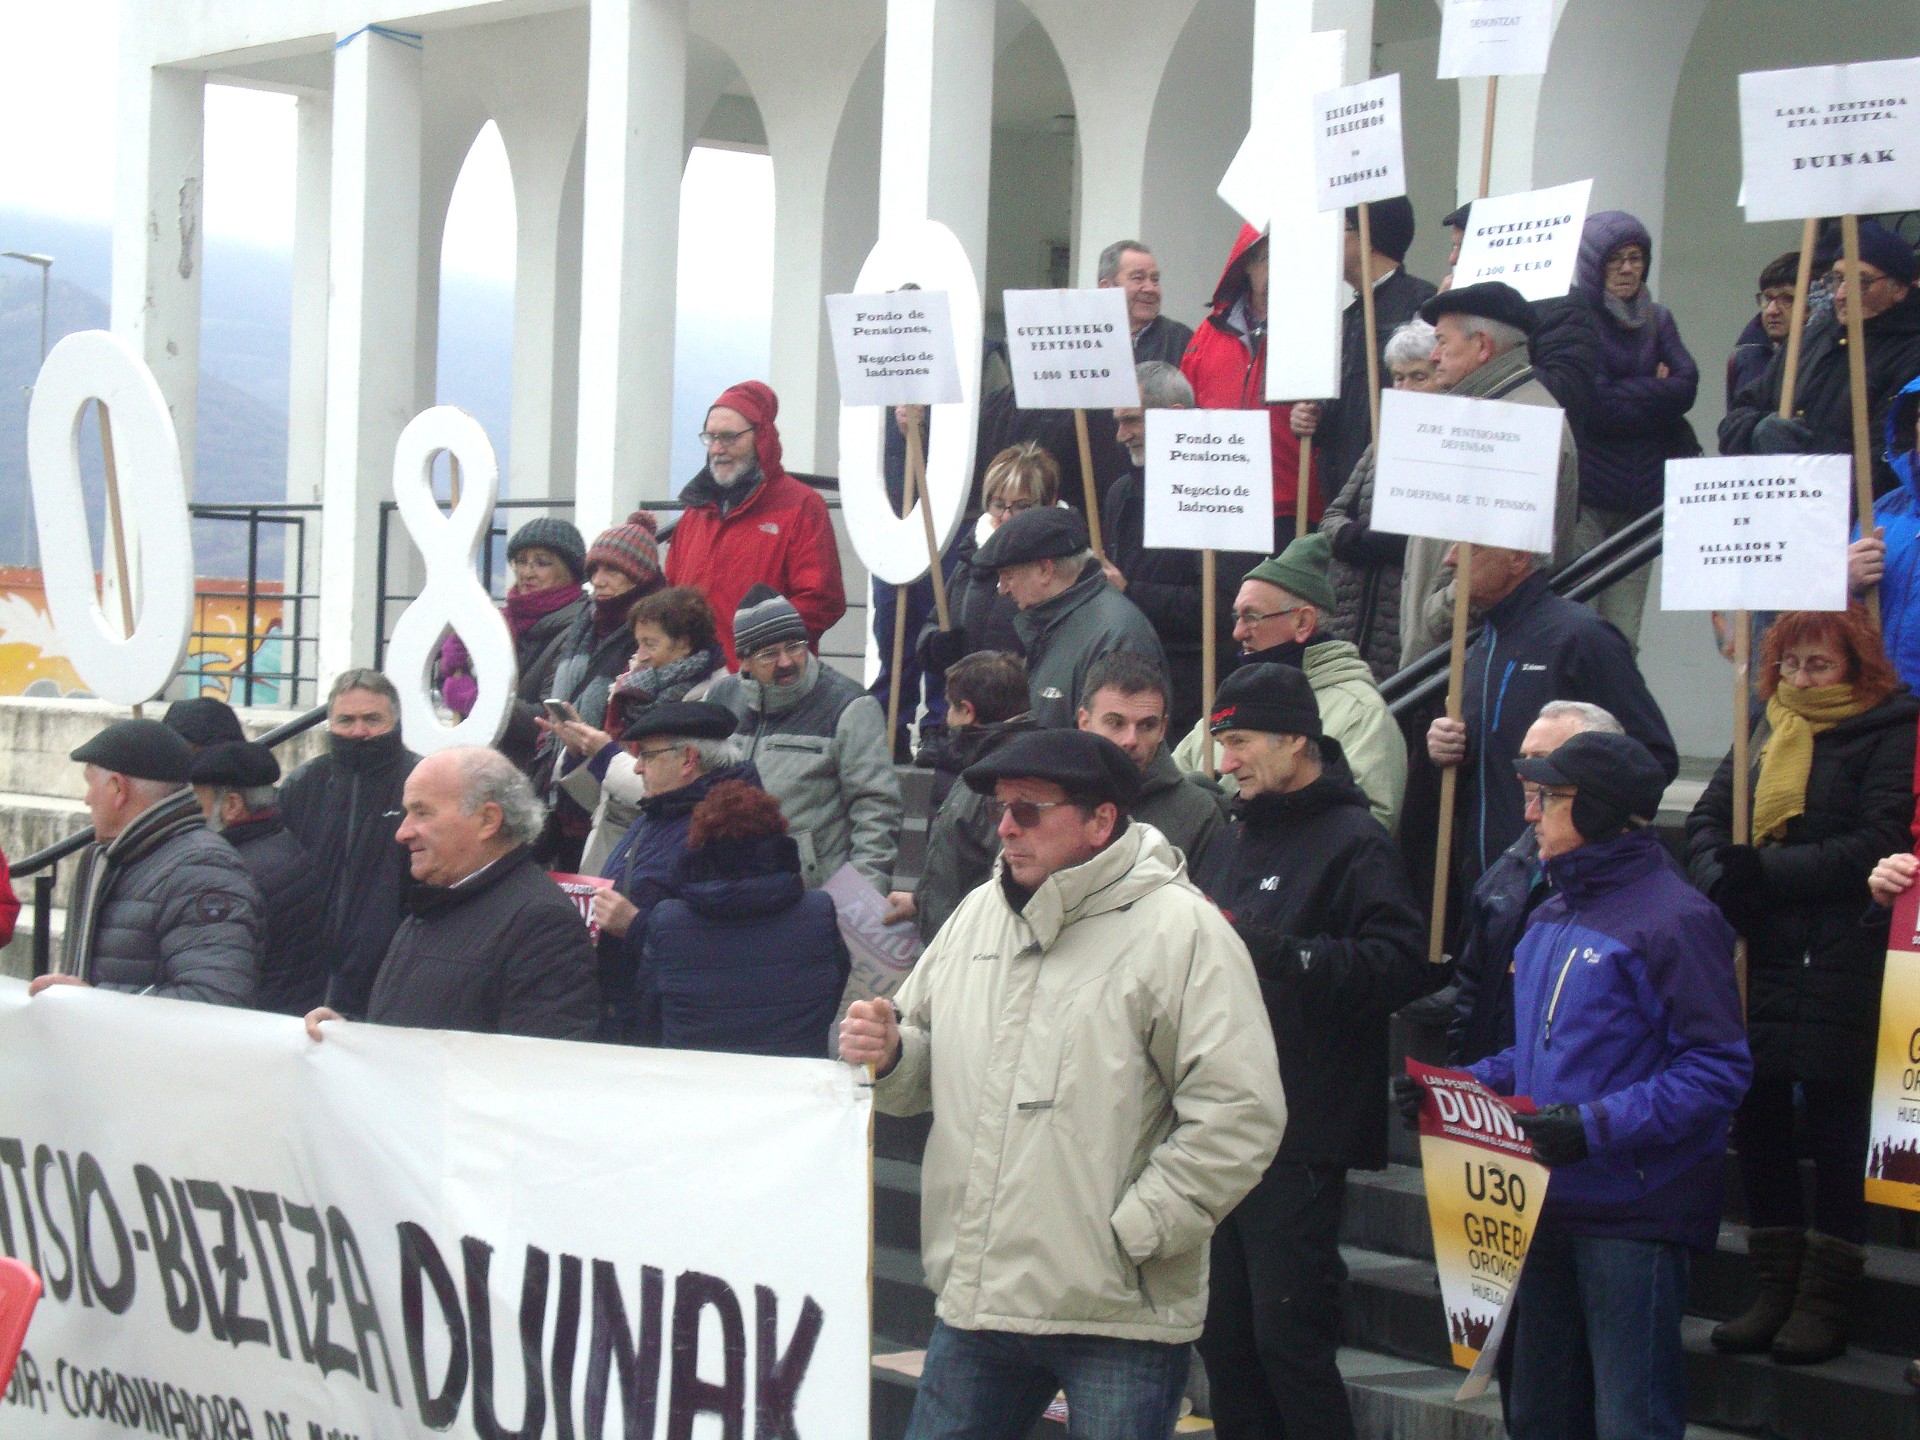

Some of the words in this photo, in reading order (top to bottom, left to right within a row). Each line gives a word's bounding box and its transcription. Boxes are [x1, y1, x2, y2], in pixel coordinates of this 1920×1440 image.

[1325, 97, 1385, 121] EXIGIMOS
[1793, 149, 1896, 170] DUINAK
[1329, 165, 1388, 187] LIMOSNAS
[1477, 214, 1572, 236] GUTXIENEKO
[1488, 232, 1553, 248] SOLDATA
[1513, 259, 1553, 273] EURO
[856, 310, 903, 322] Fondo
[908, 309, 925, 319] de
[853, 325, 932, 336] Pensiones,
[1017, 323, 1114, 336] GUTXIENEKO
[1031, 340, 1103, 351] PENTSIOA
[858, 352, 916, 365] Negocio
[918, 351, 935, 361] de
[865, 367, 930, 377] ladrones
[1069, 368, 1110, 379] EURO
[1175, 433, 1222, 444] Fondo
[1228, 433, 1245, 445] de
[1169, 450, 1250, 463] Pensiones,
[1171, 484, 1231, 498] Negocio
[1233, 485, 1250, 497] de
[1178, 500, 1244, 513] ladrones
[1733, 517, 1750, 526] EN
[1700, 541, 1771, 553] SALARIOS
[1778, 540, 1787, 549] Y
[1704, 553, 1783, 566] PENSIONES
[1465, 1161, 1526, 1212] U30
